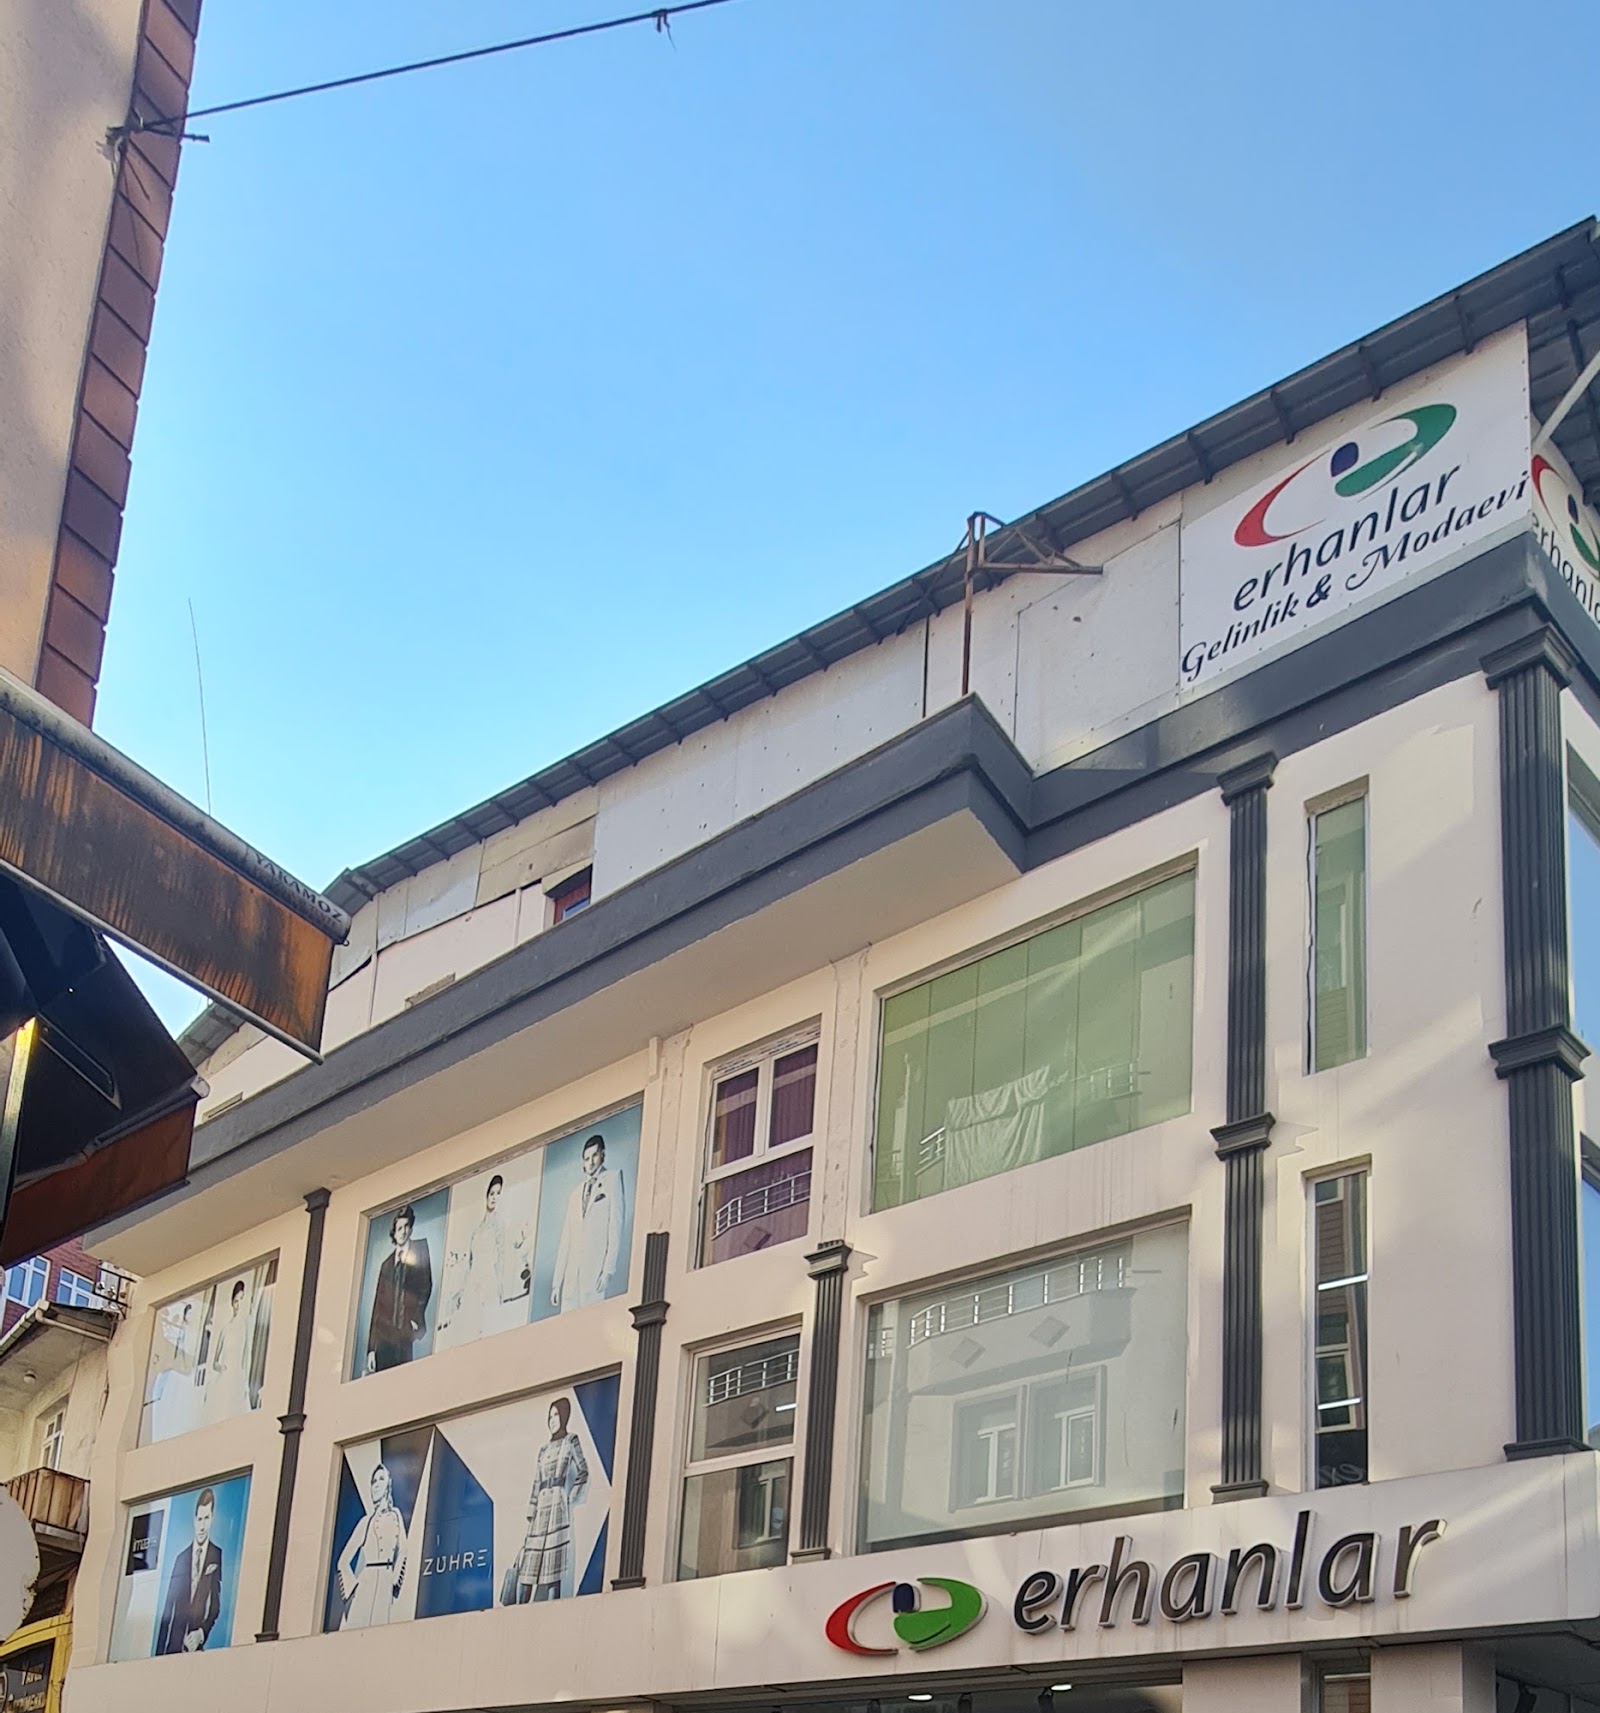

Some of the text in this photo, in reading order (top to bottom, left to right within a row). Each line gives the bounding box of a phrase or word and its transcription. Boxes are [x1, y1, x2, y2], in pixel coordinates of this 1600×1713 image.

[1181, 470, 1530, 683] Gelinlik & Modaevi
[1233, 464, 1460, 612] erhanlar
[1013, 1509, 1447, 1635] erhanlar
